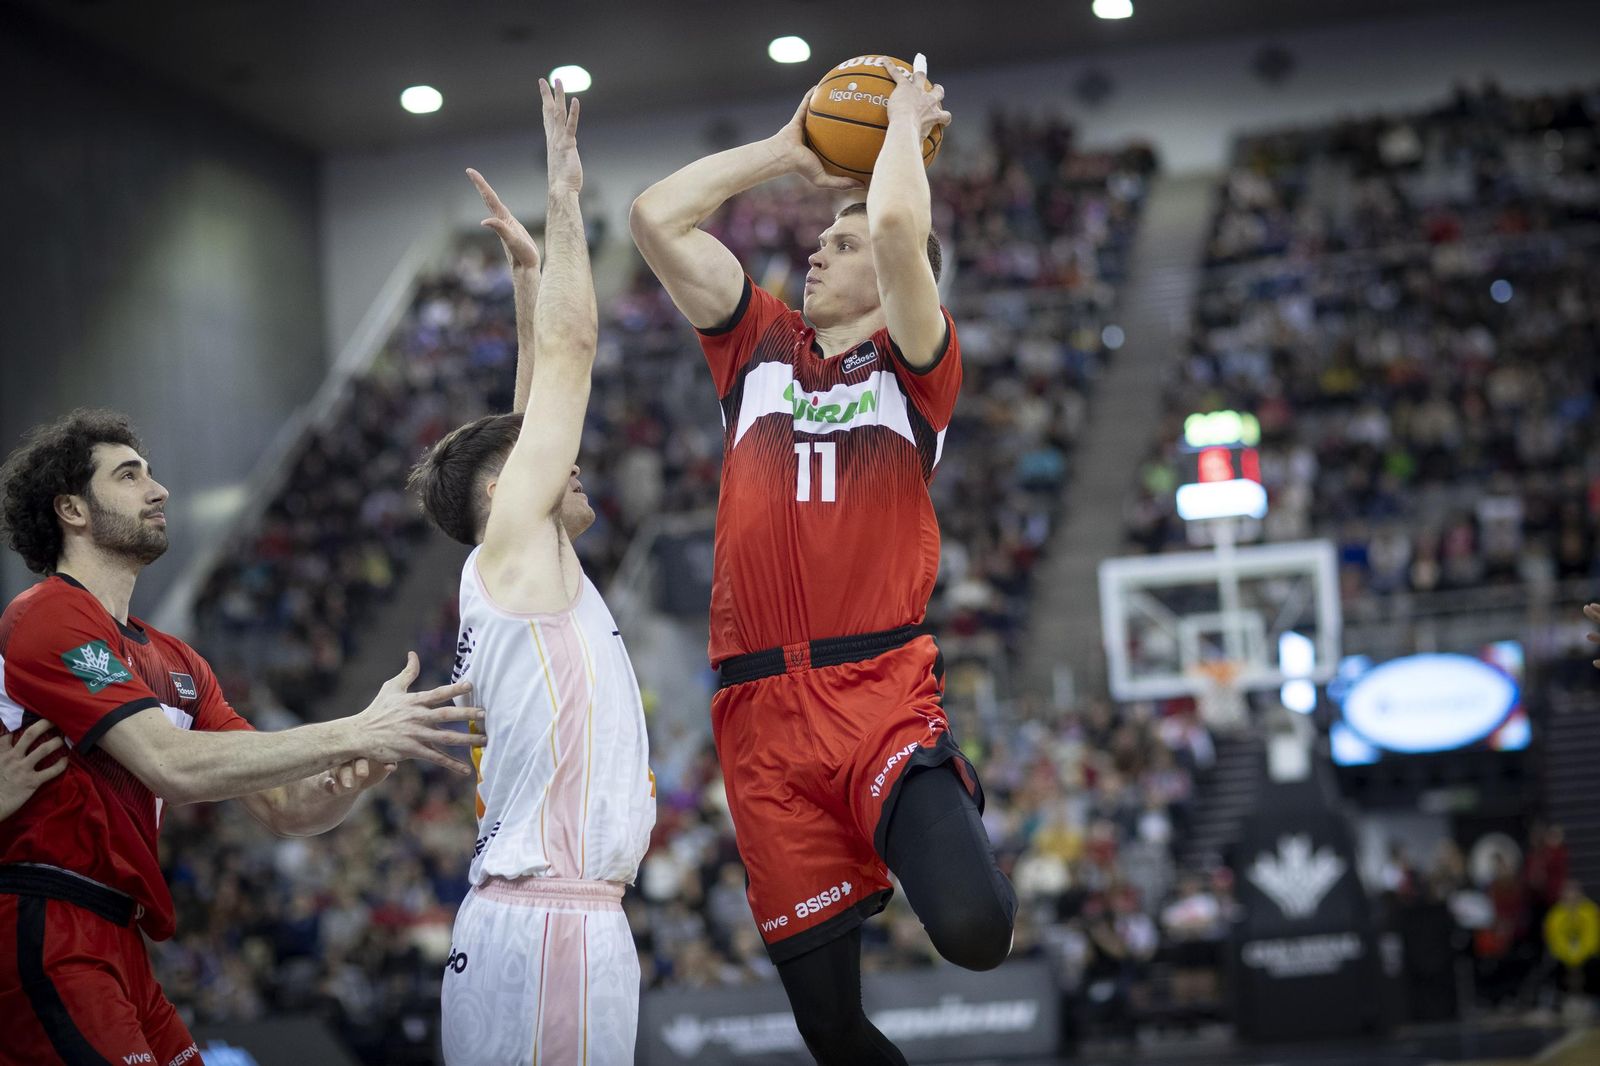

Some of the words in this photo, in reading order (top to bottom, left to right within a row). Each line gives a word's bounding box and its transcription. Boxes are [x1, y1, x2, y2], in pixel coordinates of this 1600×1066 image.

[829, 88, 852, 102] liga
[845, 351, 876, 370] endesa
[795, 441, 836, 503] 11
[761, 915, 788, 933] vive
[794, 886, 841, 918] asisa
[122, 1051, 152, 1066] vive
